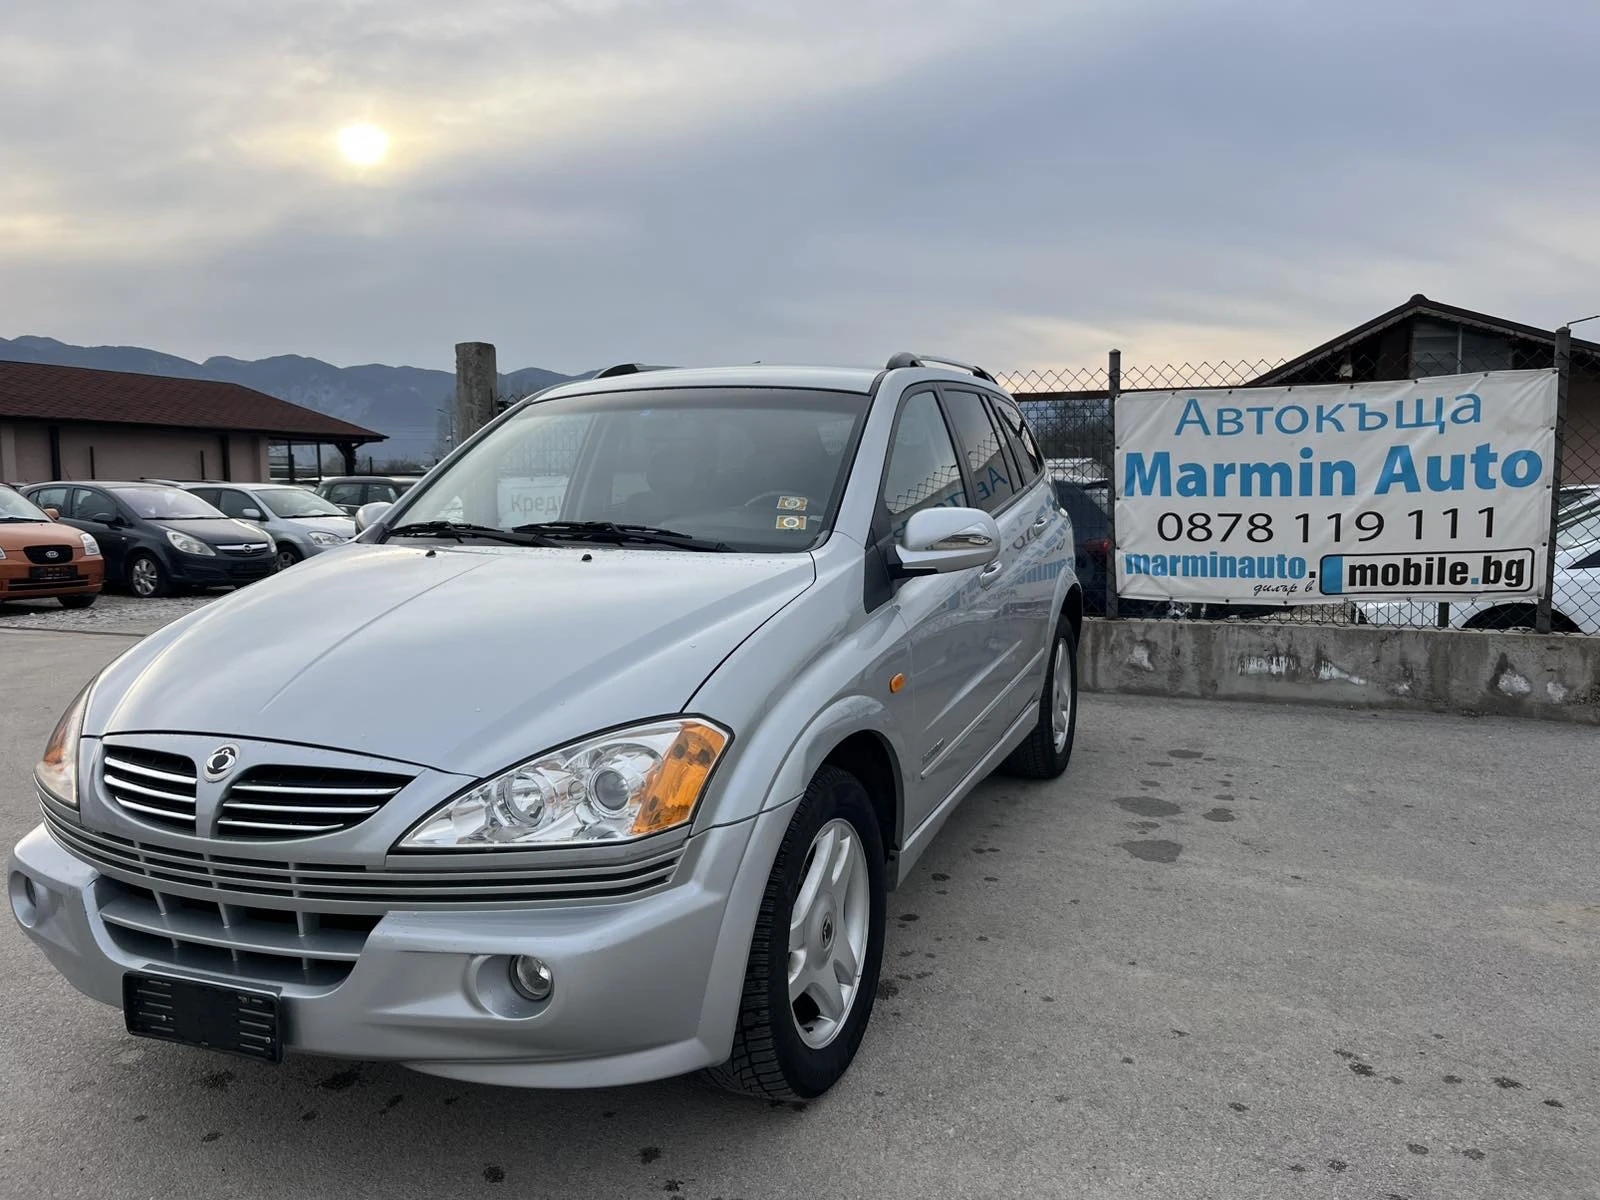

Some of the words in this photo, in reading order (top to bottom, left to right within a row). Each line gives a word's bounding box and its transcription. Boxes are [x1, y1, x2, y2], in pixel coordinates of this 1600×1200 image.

[1174, 393, 1482, 435] Автокъща
[1124, 447, 1356, 498] Marmin
[1374, 443, 1543, 495] Auto
[1157, 512, 1275, 544] 0878
[1295, 512, 1385, 543] 119
[1408, 507, 1496, 541] 111
[1125, 551, 1317, 579] marminauto.
[1348, 555, 1526, 588] mobile.bg
